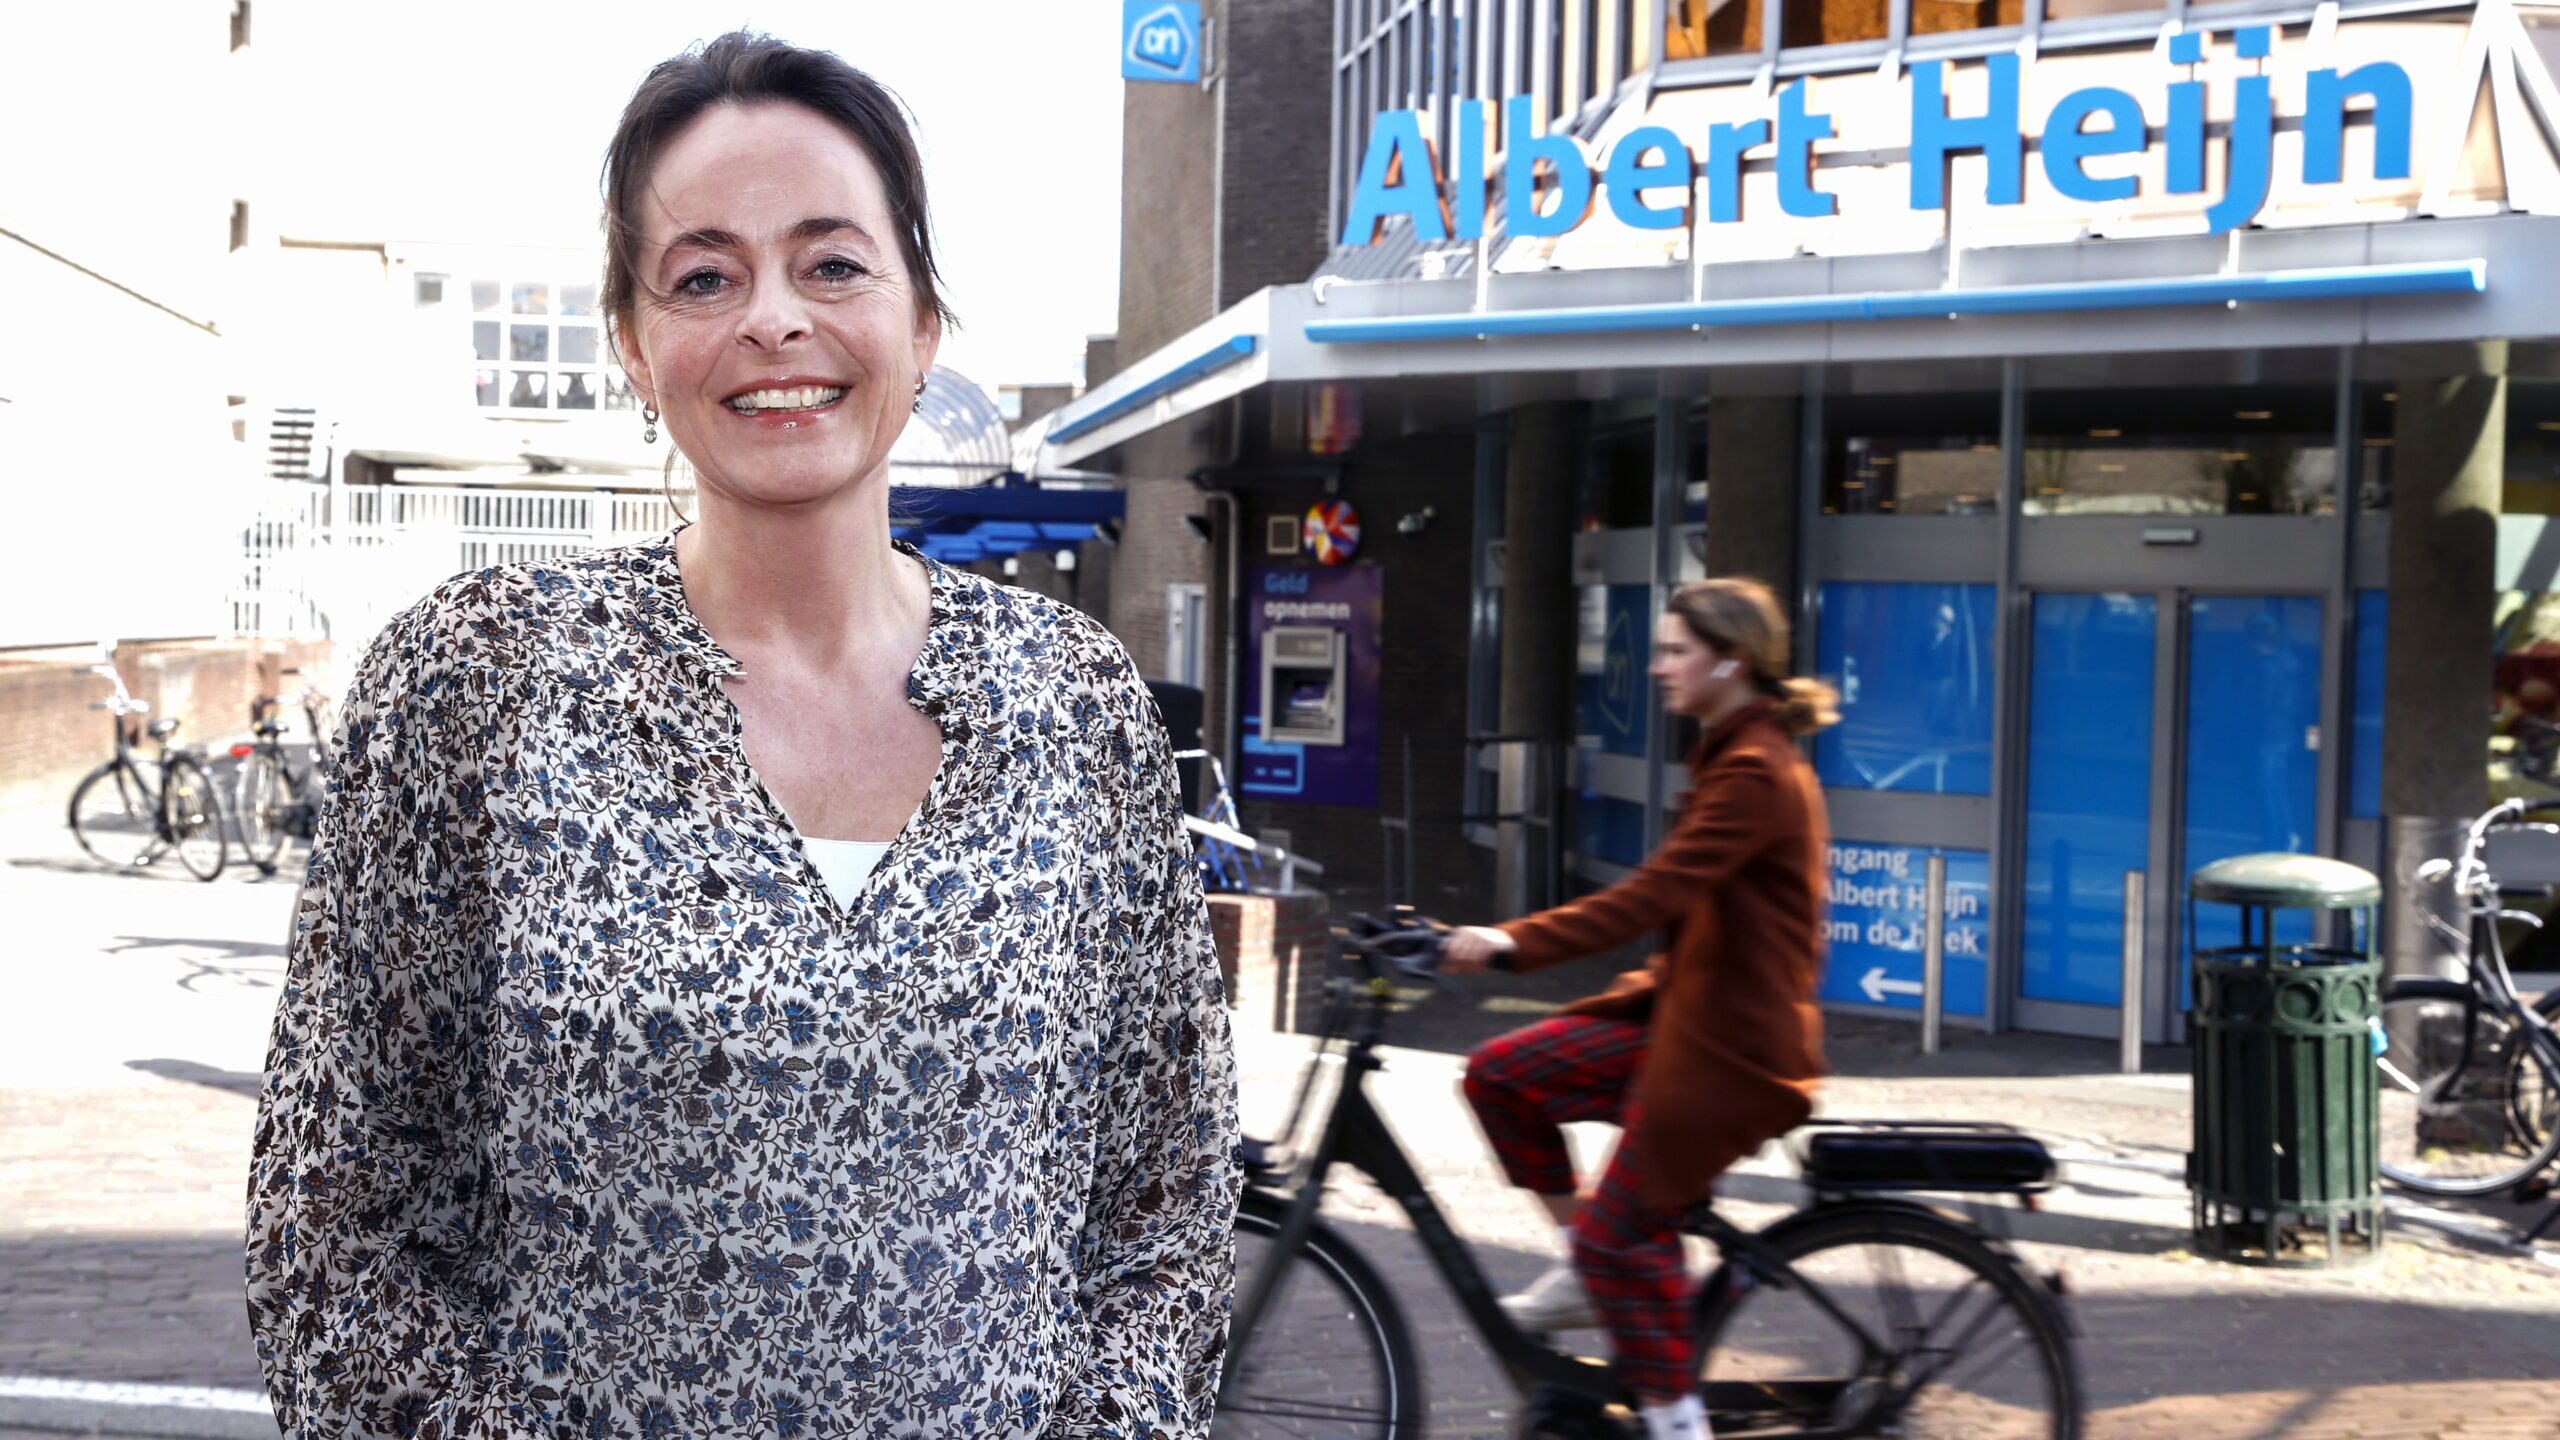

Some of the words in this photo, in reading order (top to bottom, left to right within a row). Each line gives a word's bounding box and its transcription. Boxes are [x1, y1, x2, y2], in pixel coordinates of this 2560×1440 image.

[1341, 78, 1838, 245] Albert
[1910, 26, 2413, 234] Heijn
[1264, 572, 1308, 593] Geld
[1263, 601, 1351, 622] opnemen
[1822, 846, 1910, 878] ngang
[1906, 884, 1978, 920] Hijn
[1867, 918, 1902, 948] de
[1909, 920, 1979, 955] hek
